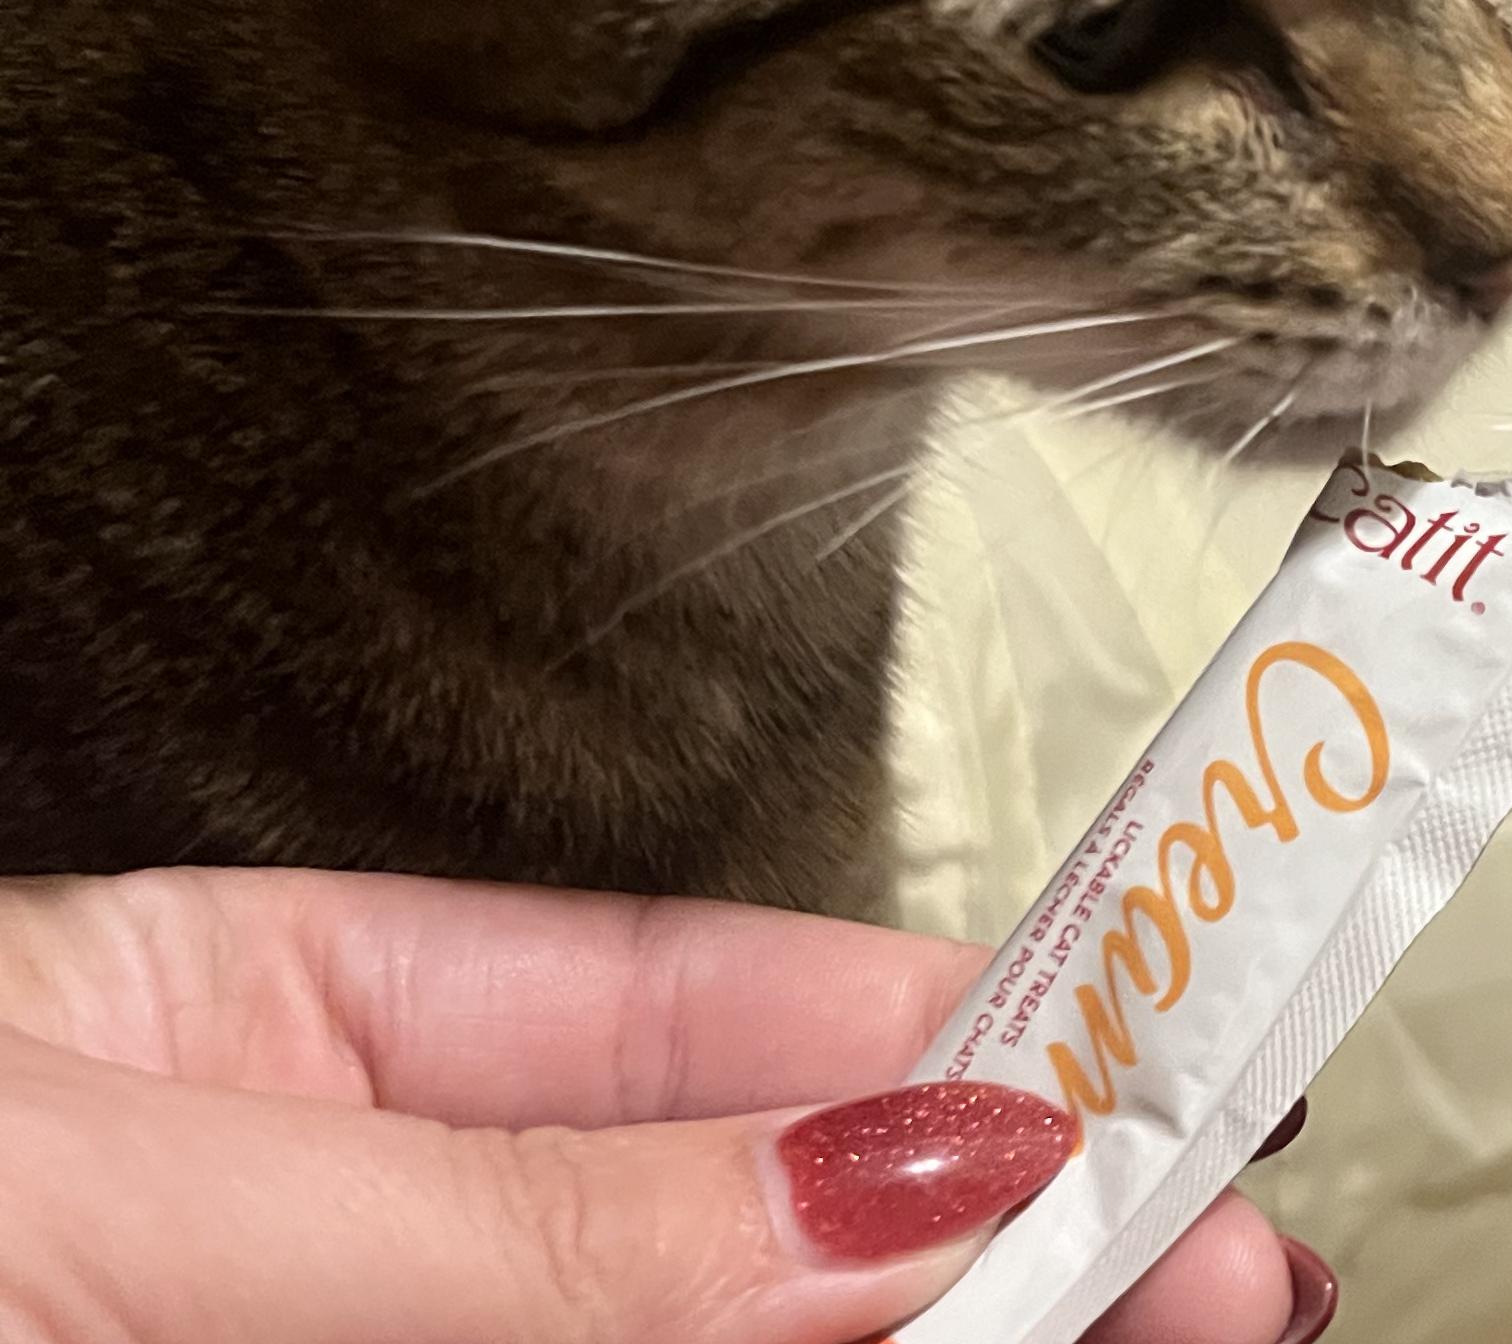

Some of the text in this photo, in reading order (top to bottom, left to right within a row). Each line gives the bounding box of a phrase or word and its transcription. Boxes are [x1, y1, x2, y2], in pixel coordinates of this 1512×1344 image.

[1000, 820, 1144, 1048] LICKABLE CAT TREATS
[987, 946, 1035, 1009] POUR
[946, 1013, 994, 1081] CHATS
